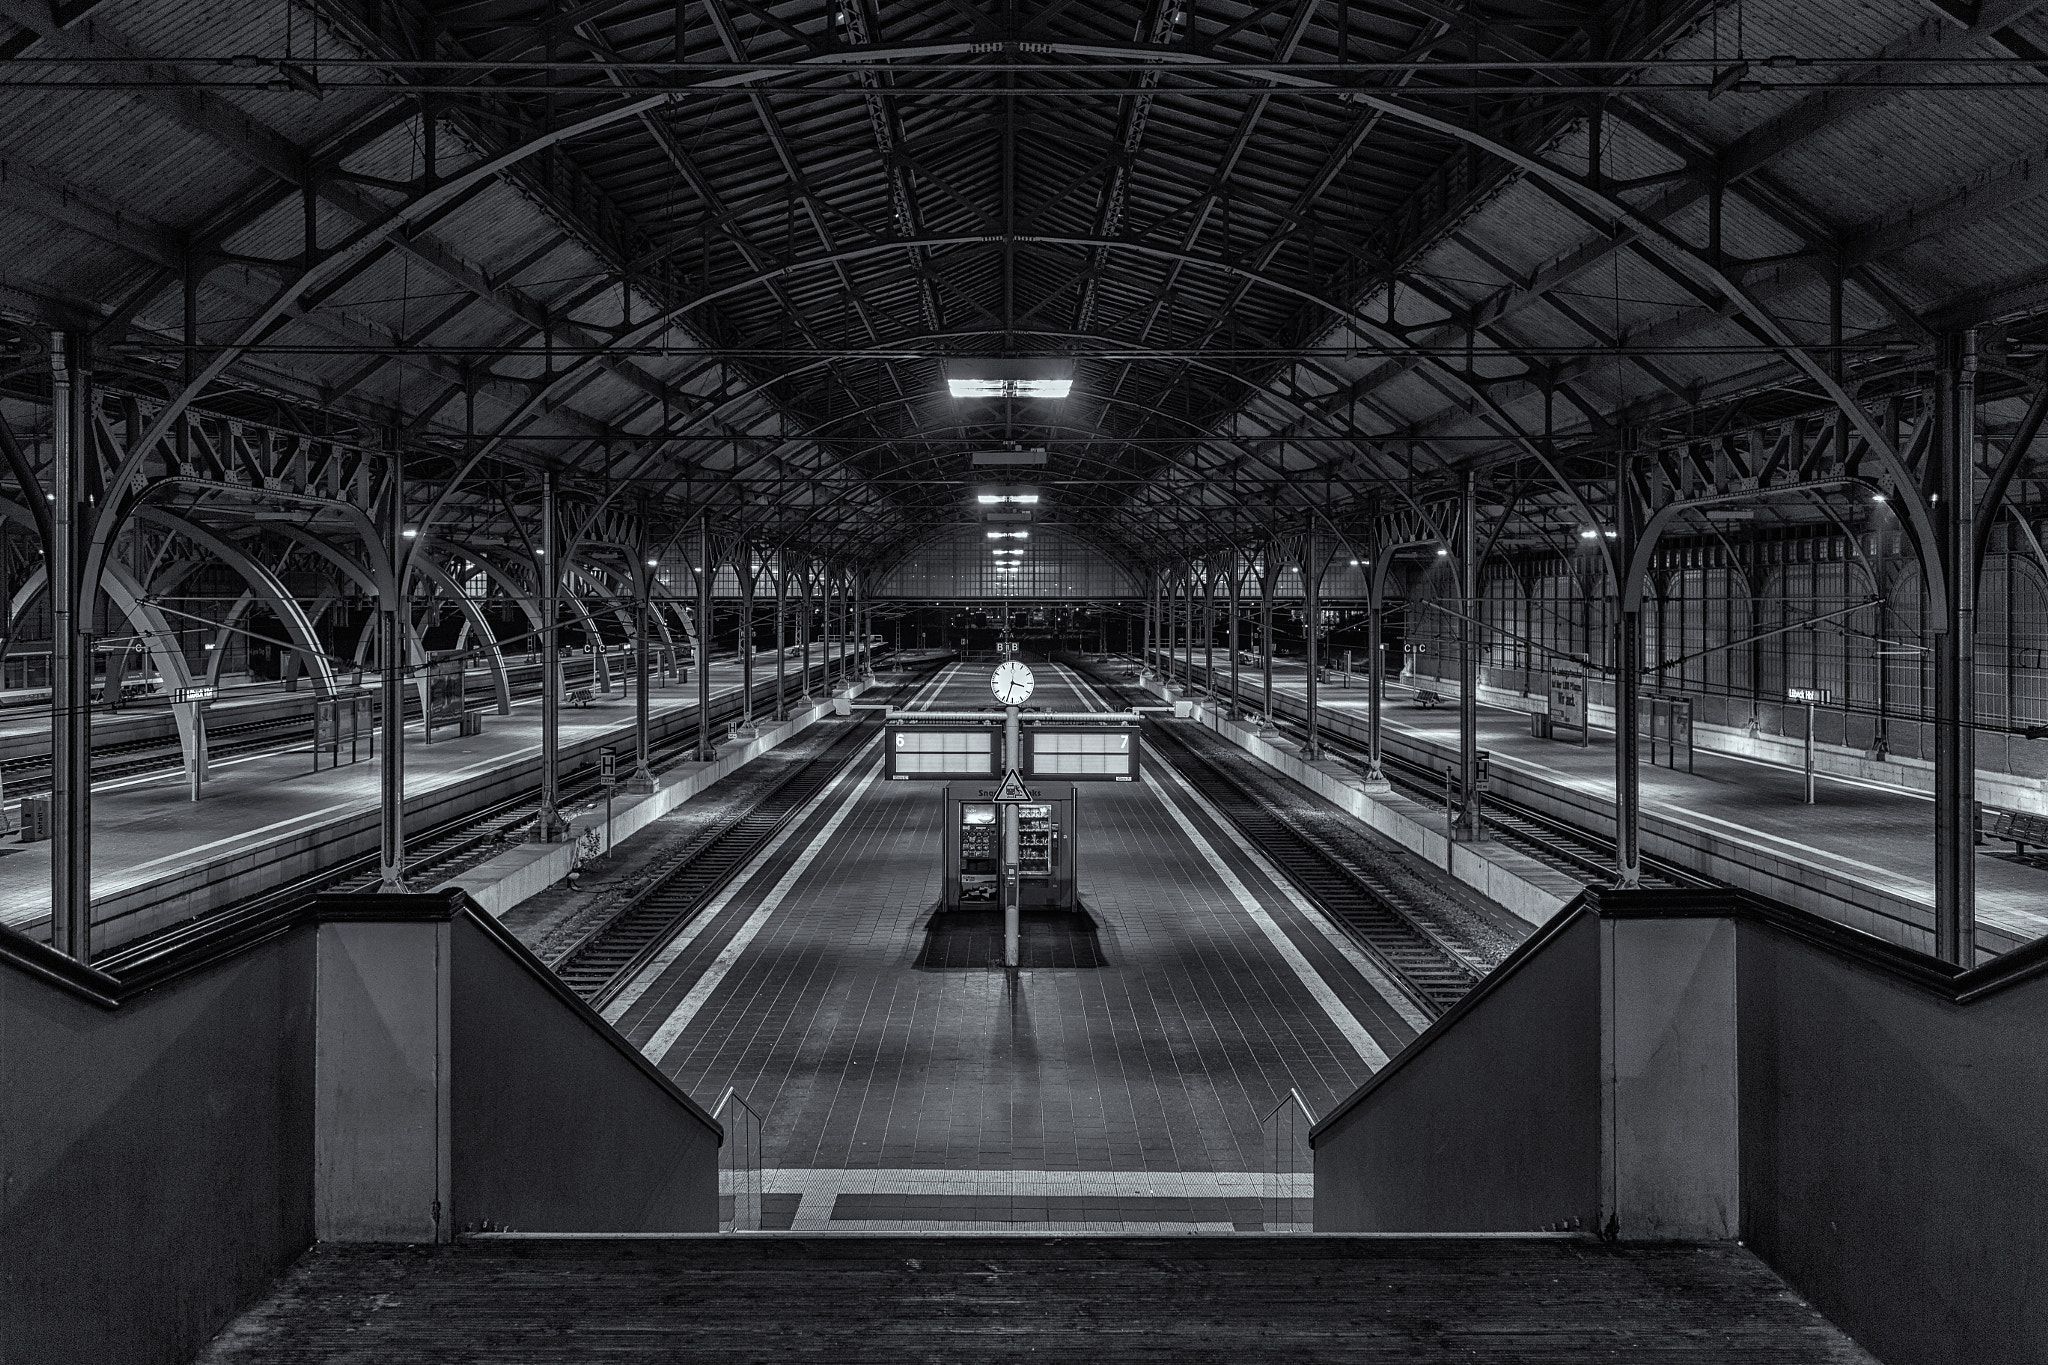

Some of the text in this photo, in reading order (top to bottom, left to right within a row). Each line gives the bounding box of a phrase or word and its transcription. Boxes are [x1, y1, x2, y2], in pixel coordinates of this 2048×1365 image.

[584, 644, 591, 653] C
[599, 644, 606, 653] C
[997, 643, 1003, 651] B
[1012, 643, 1018, 651] B
[1405, 644, 1411, 653] C
[1419, 644, 1426, 653] C
[896, 733, 905, 747] 6
[1120, 735, 1129, 749] 7
[602, 756, 614, 775] H
[1475, 761, 1488, 780] H
